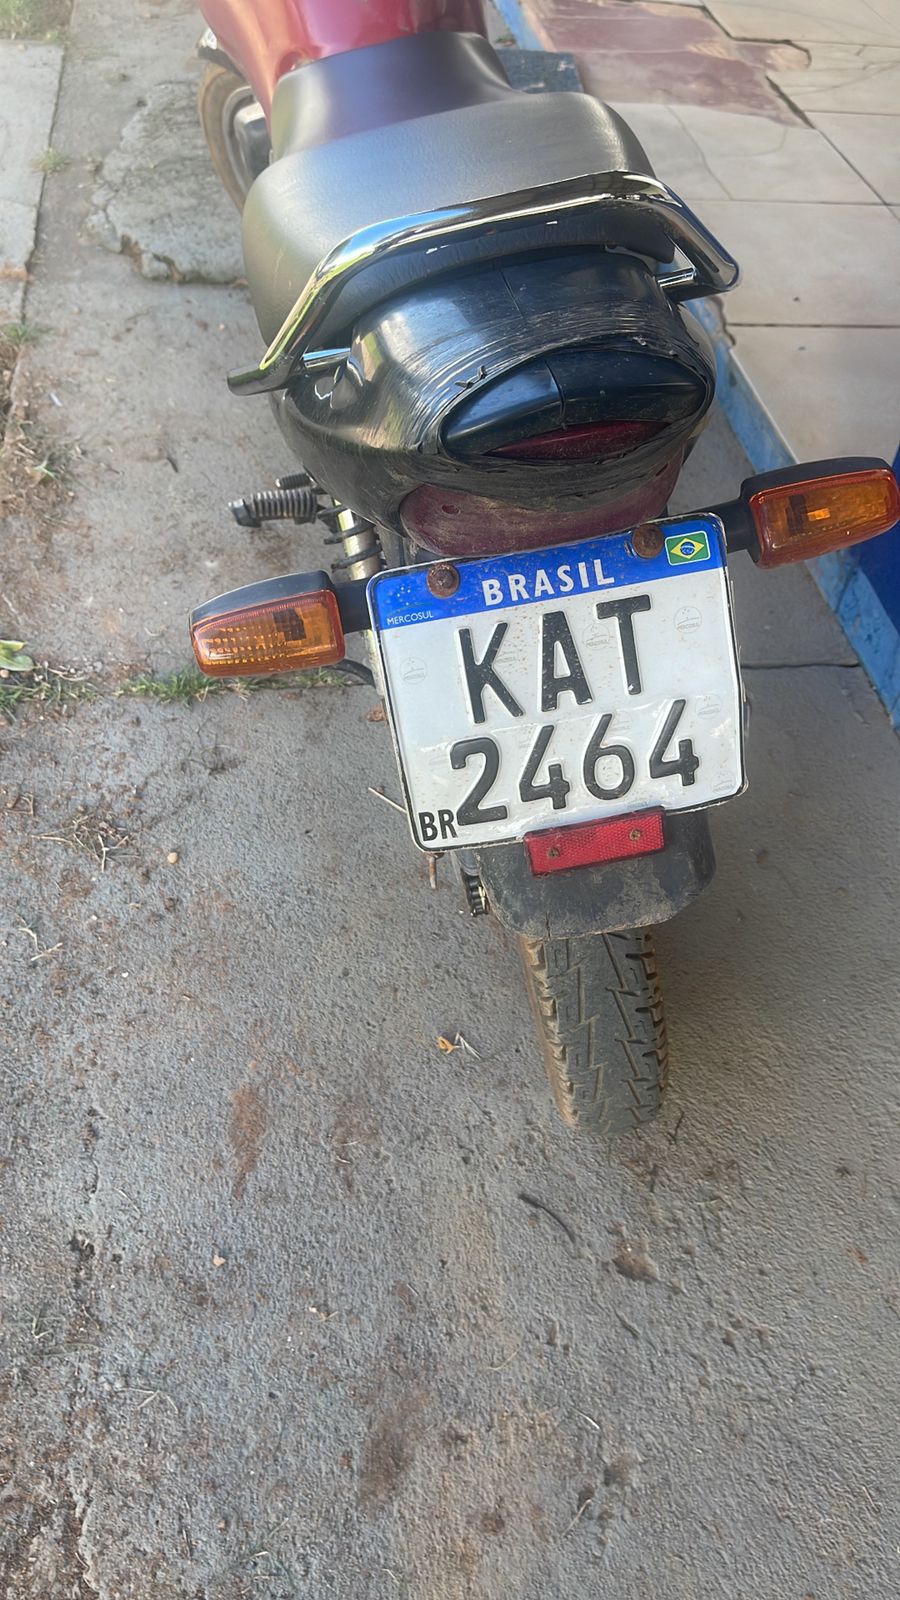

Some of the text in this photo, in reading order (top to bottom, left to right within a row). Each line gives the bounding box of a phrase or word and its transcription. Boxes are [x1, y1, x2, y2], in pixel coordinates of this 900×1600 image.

[483, 560, 615, 605] BRASIL
[386, 610, 434, 626] MERCOSUL
[458, 595, 651, 723] KAT
[450, 699, 699, 826] 2464
[419, 809, 458, 841] BR
